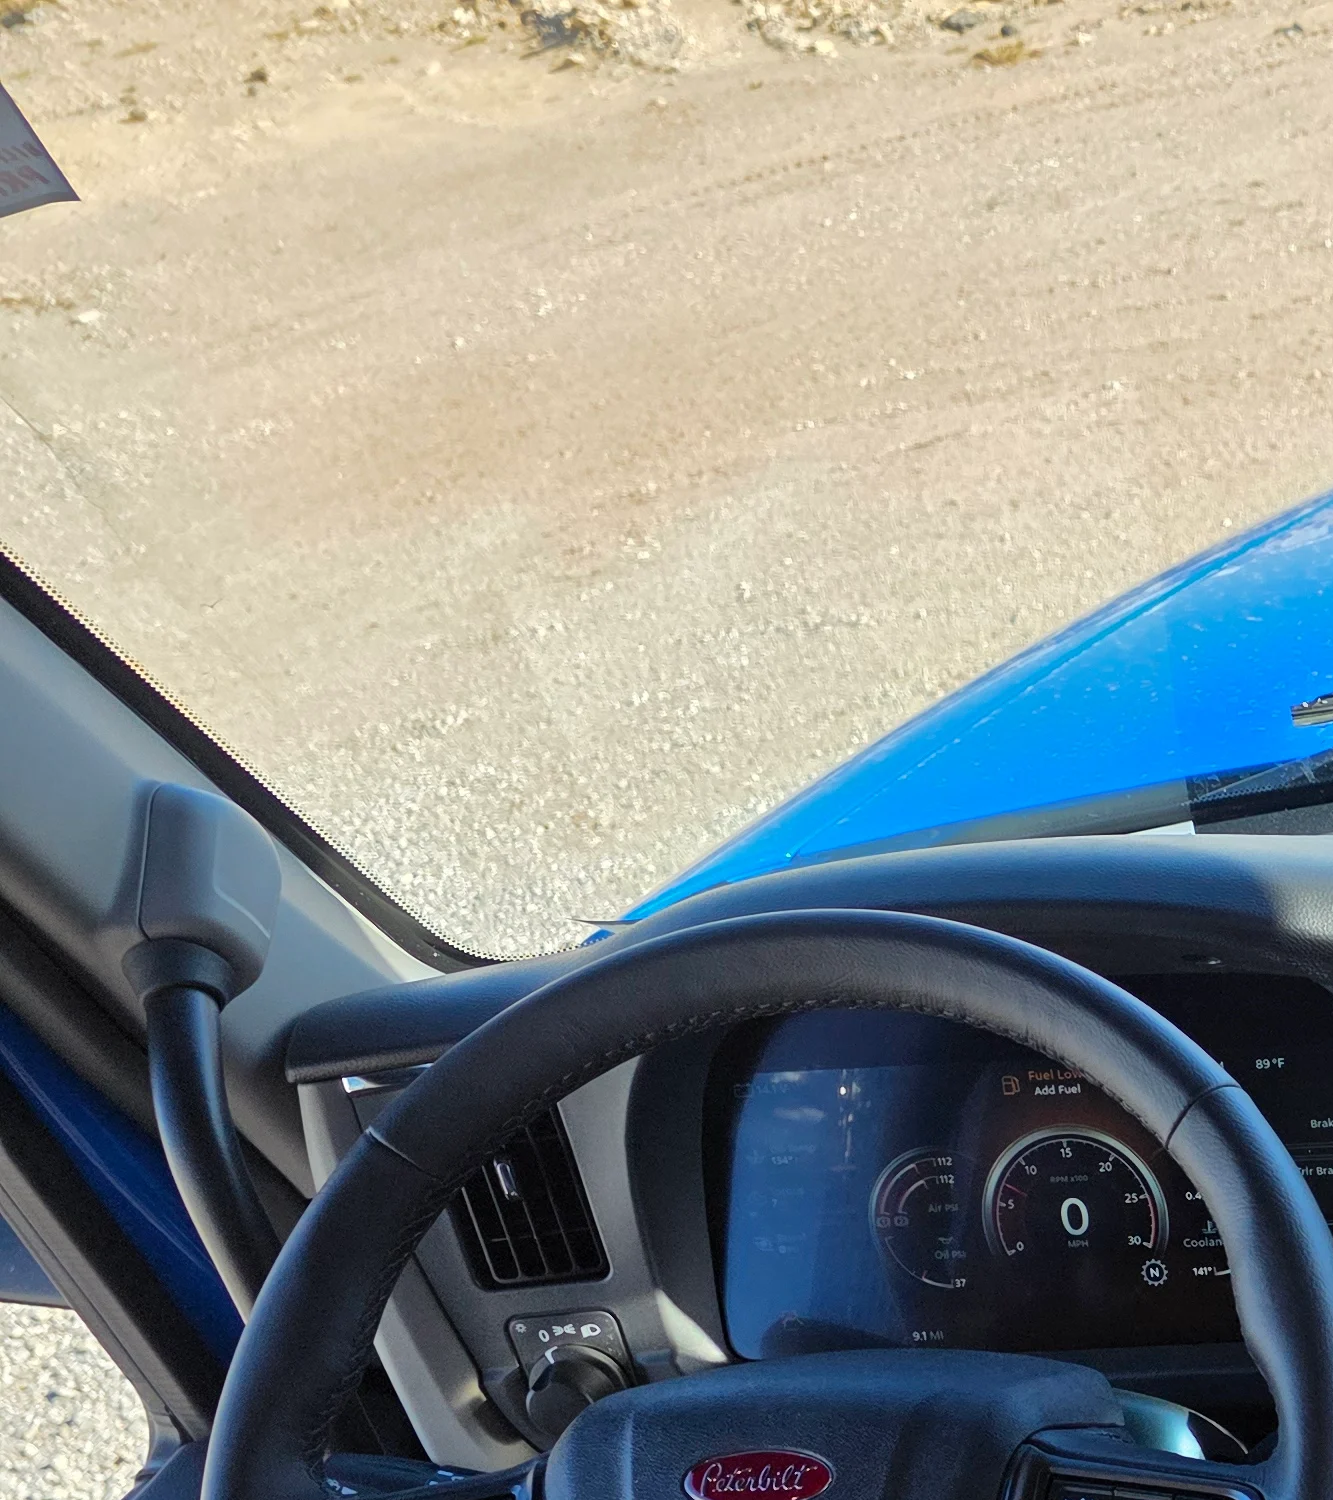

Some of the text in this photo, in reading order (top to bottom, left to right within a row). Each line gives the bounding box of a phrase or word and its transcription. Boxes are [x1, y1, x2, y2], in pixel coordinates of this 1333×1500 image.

[1028, 1069, 1054, 1081] Fuel
[1034, 1083, 1081, 1096] Add Fuel
[1060, 1148, 1072, 1159] 15
[937, 1156, 952, 1166] 112
[1024, 1165, 1037, 1175] 10
[1099, 1162, 1113, 1173] 20
[939, 1174, 955, 1184] 112
[1125, 1193, 1139, 1204] 25
[1007, 1200, 1015, 1210] 5
[1060, 1197, 1089, 1236] 0
[1016, 1241, 1024, 1251] 0
[1068, 1239, 1089, 1249] MPH
[1128, 1235, 1142, 1246] 30
[1150, 1267, 1160, 1278] N
[954, 1278, 967, 1288] 37
[912, 1331, 928, 1342] 9.1
[700, 1462, 818, 1497] Peterbilt
